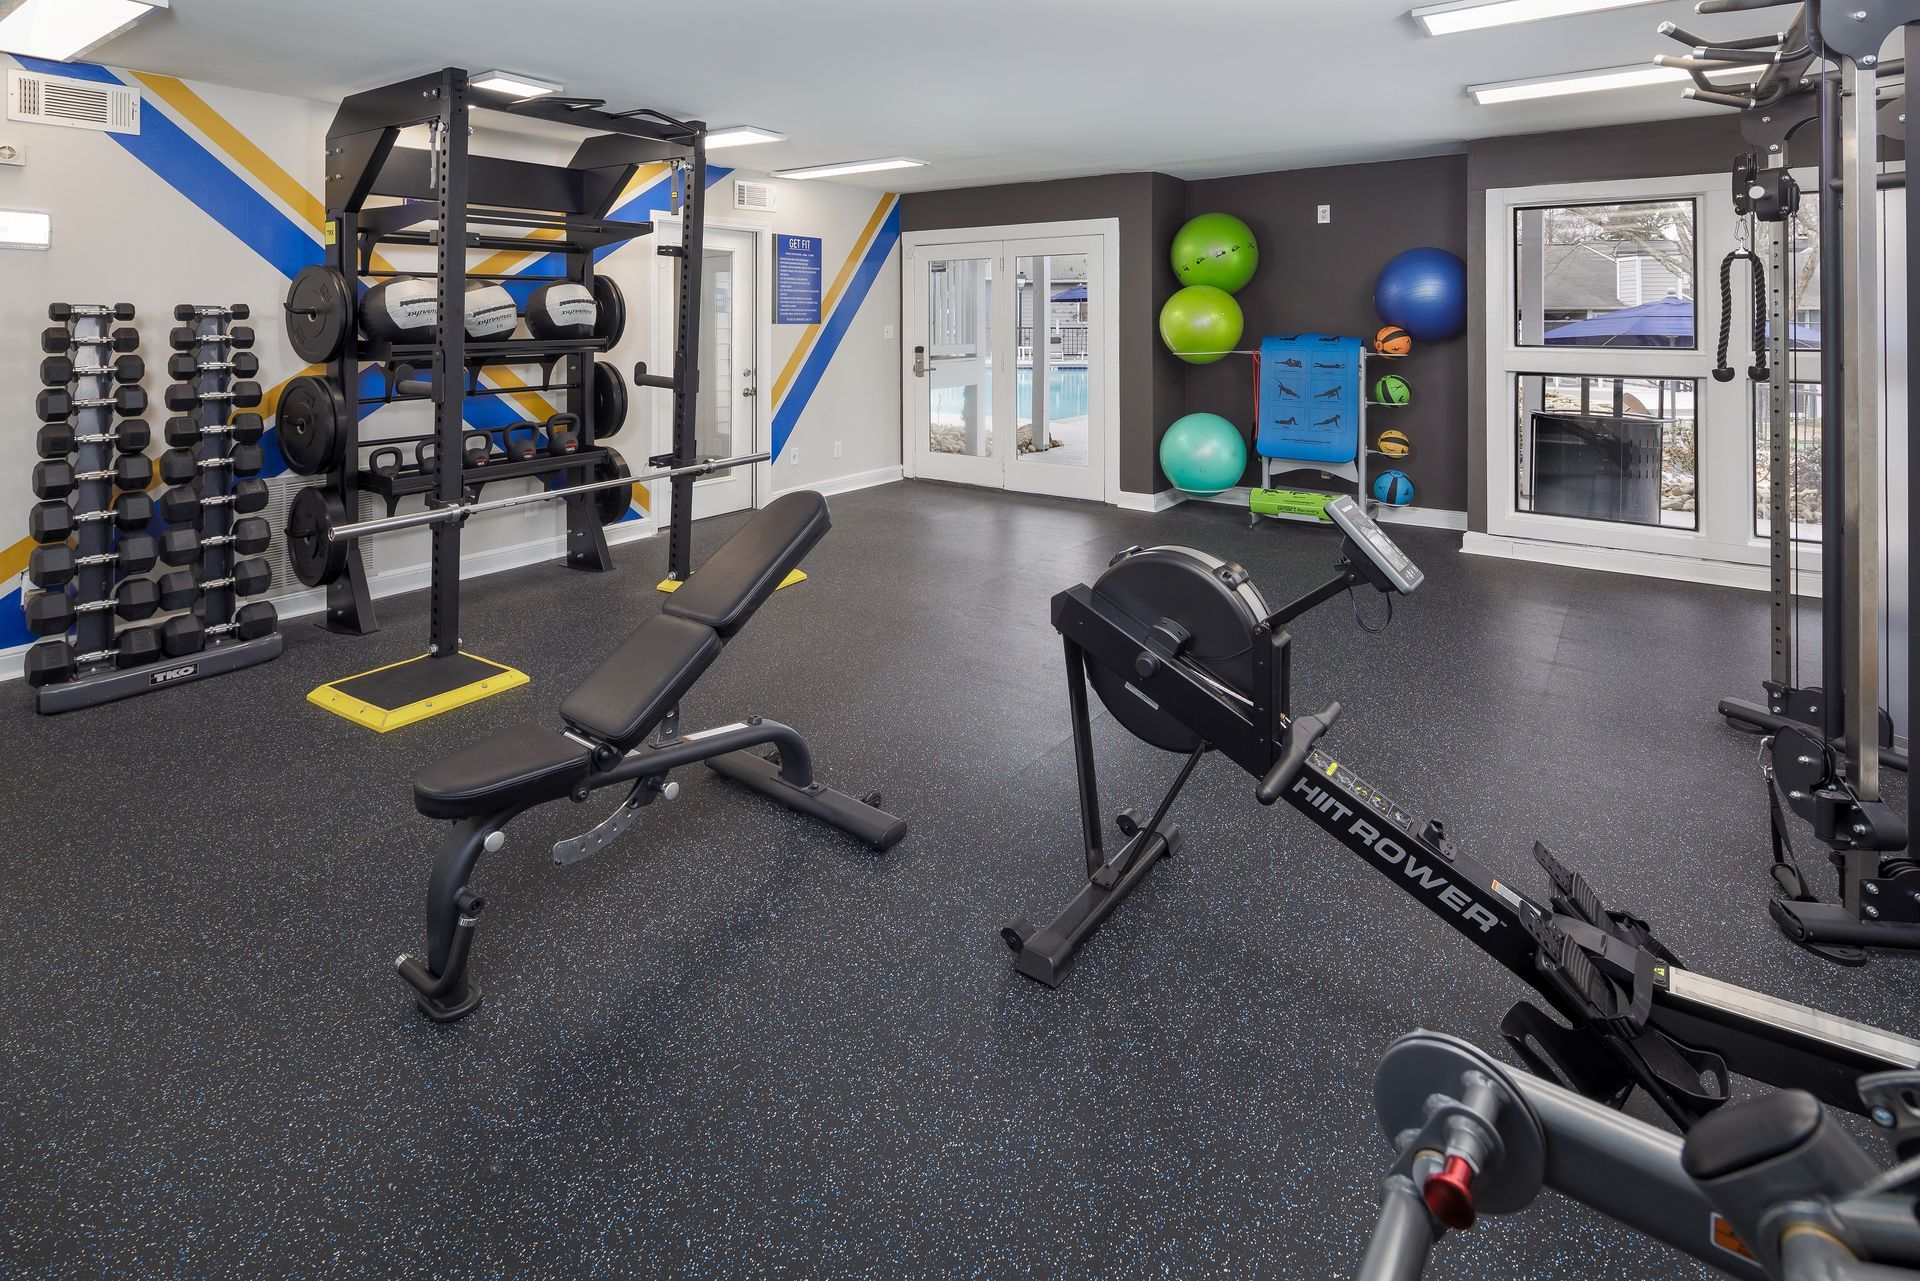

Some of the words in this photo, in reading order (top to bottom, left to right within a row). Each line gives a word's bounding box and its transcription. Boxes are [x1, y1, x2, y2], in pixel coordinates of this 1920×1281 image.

[789, 238, 800, 249] GET
[801, 239, 811, 250] FIT
[1276, 504, 1297, 512] Smart
[153, 665, 195, 682] TKO
[1292, 776, 1354, 822] HIIT
[1347, 817, 1500, 933] ROWER
